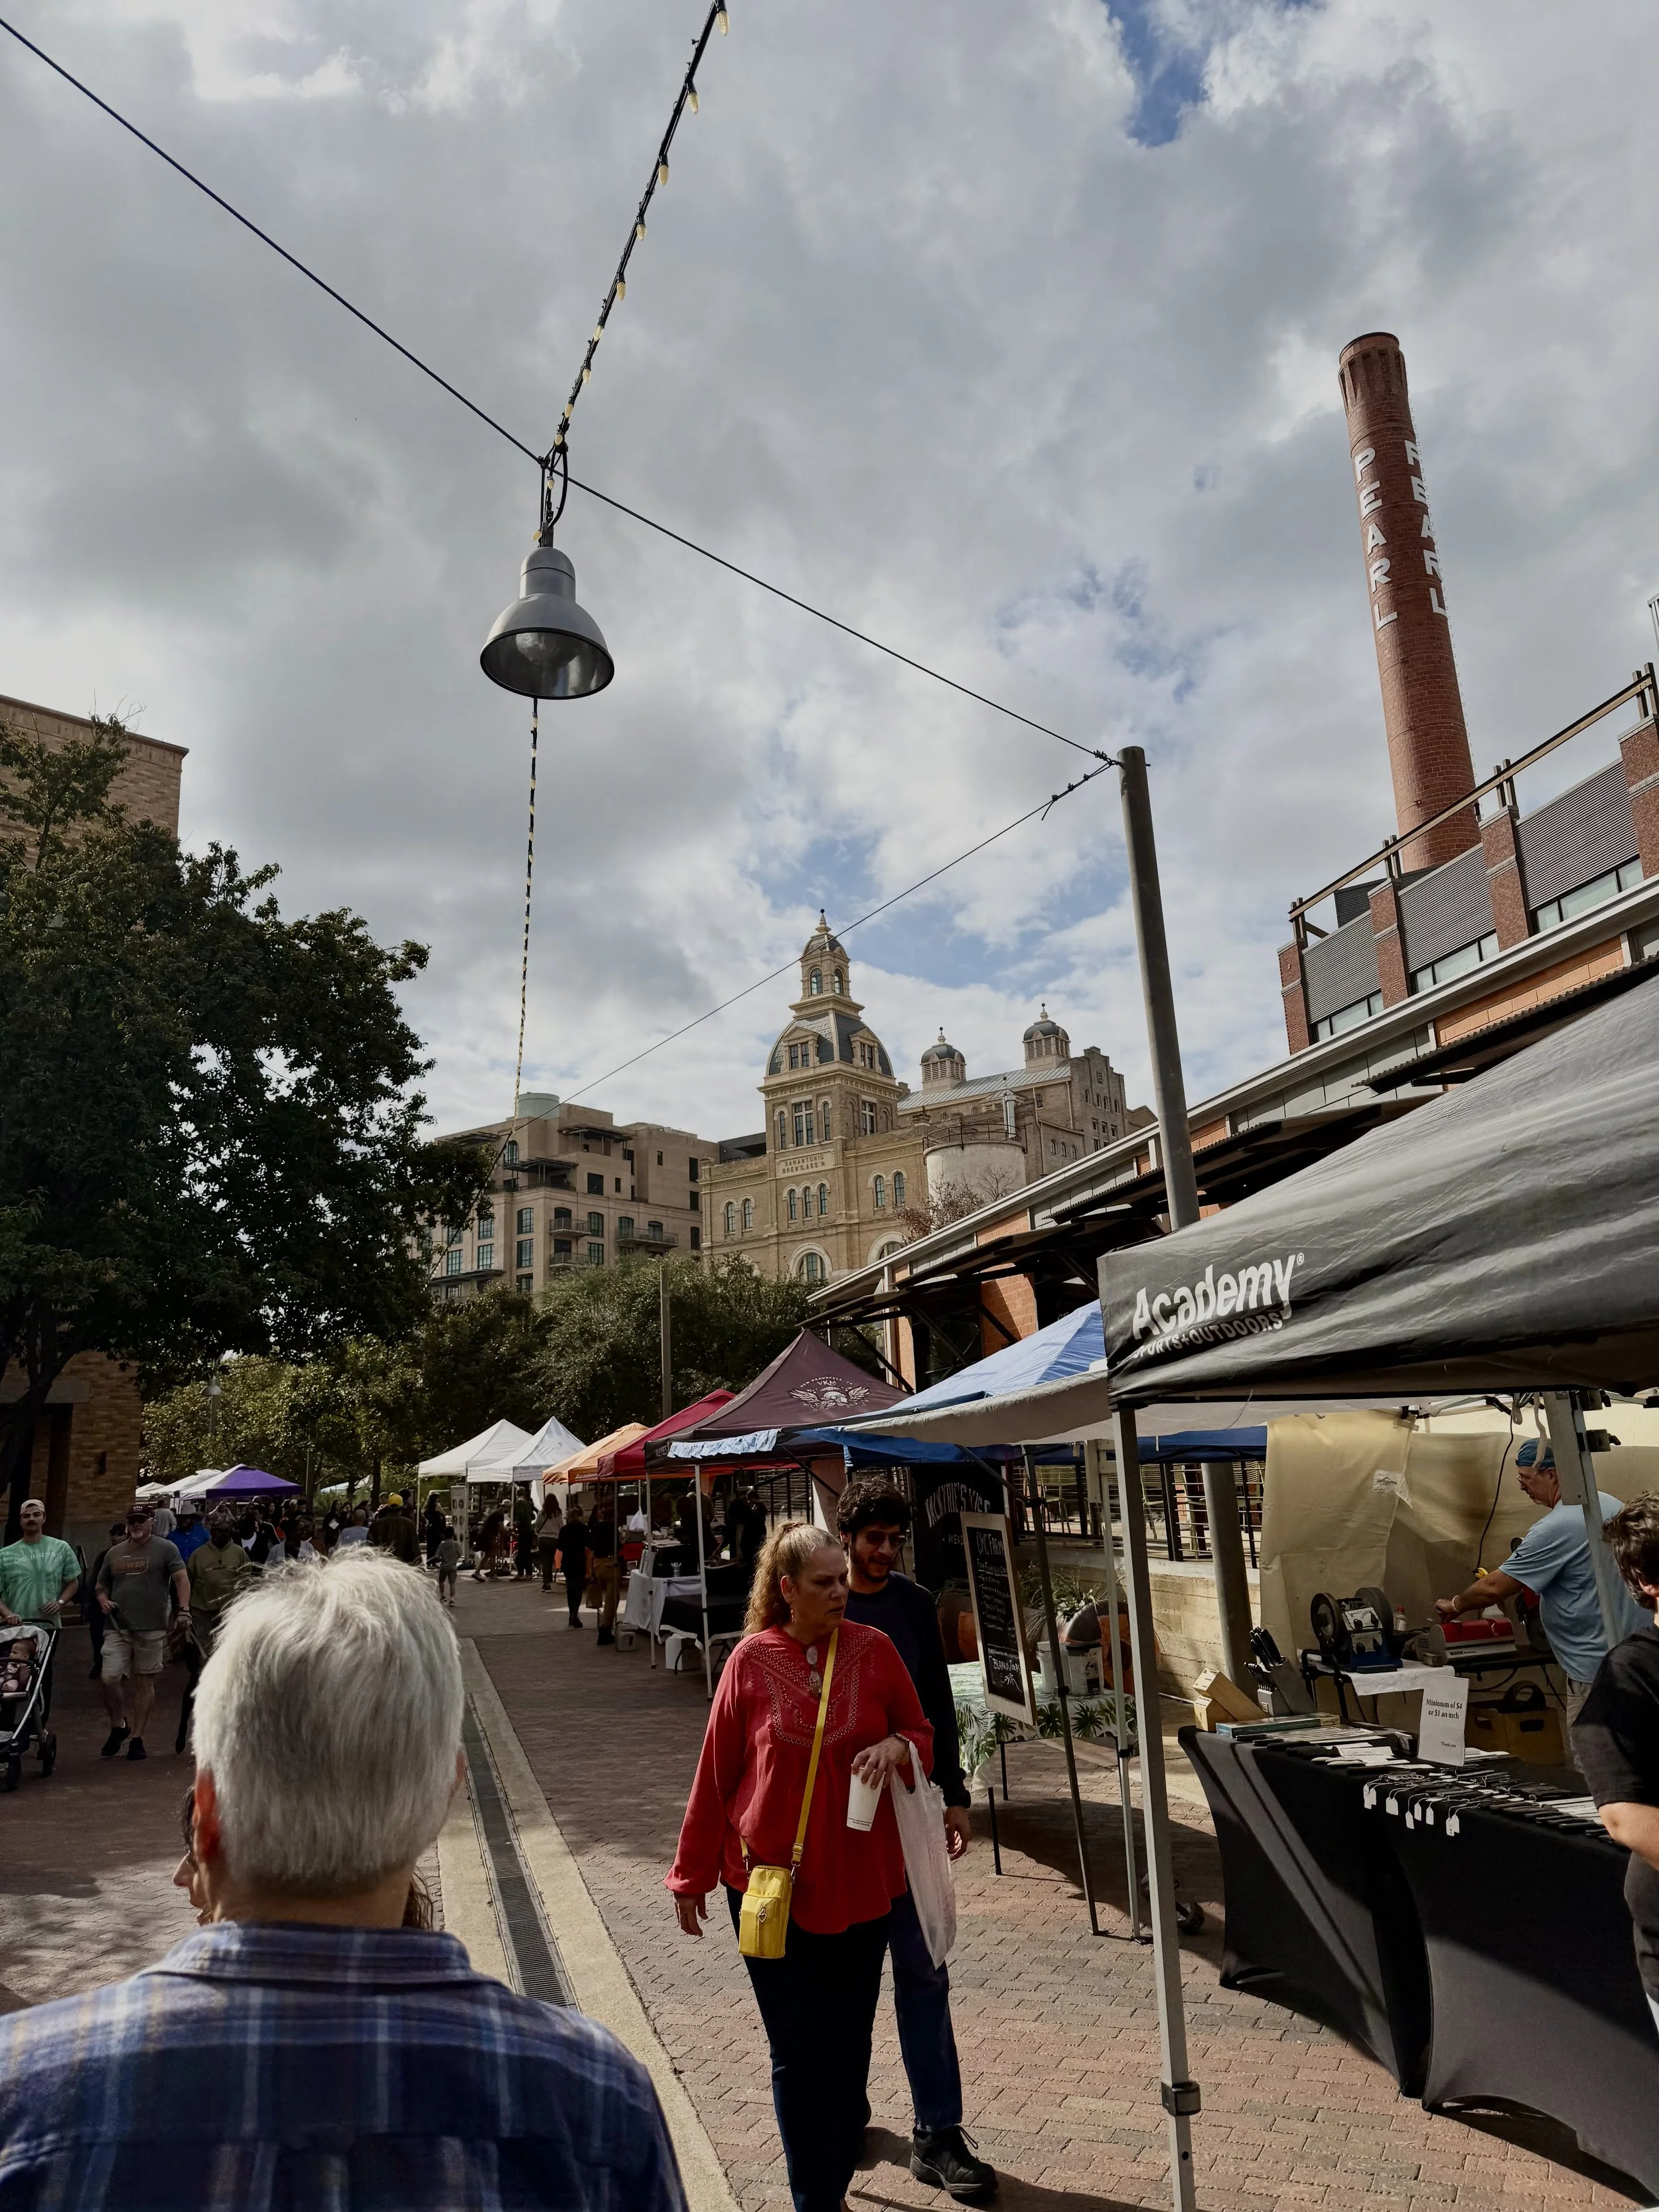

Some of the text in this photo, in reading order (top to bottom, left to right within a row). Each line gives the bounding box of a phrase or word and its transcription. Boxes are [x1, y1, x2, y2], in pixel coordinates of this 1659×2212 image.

[1354, 447, 1398, 632] PEARL
[1132, 1254, 1295, 1340] Academy
[1426, 1699, 1449, 1708] Minimum
